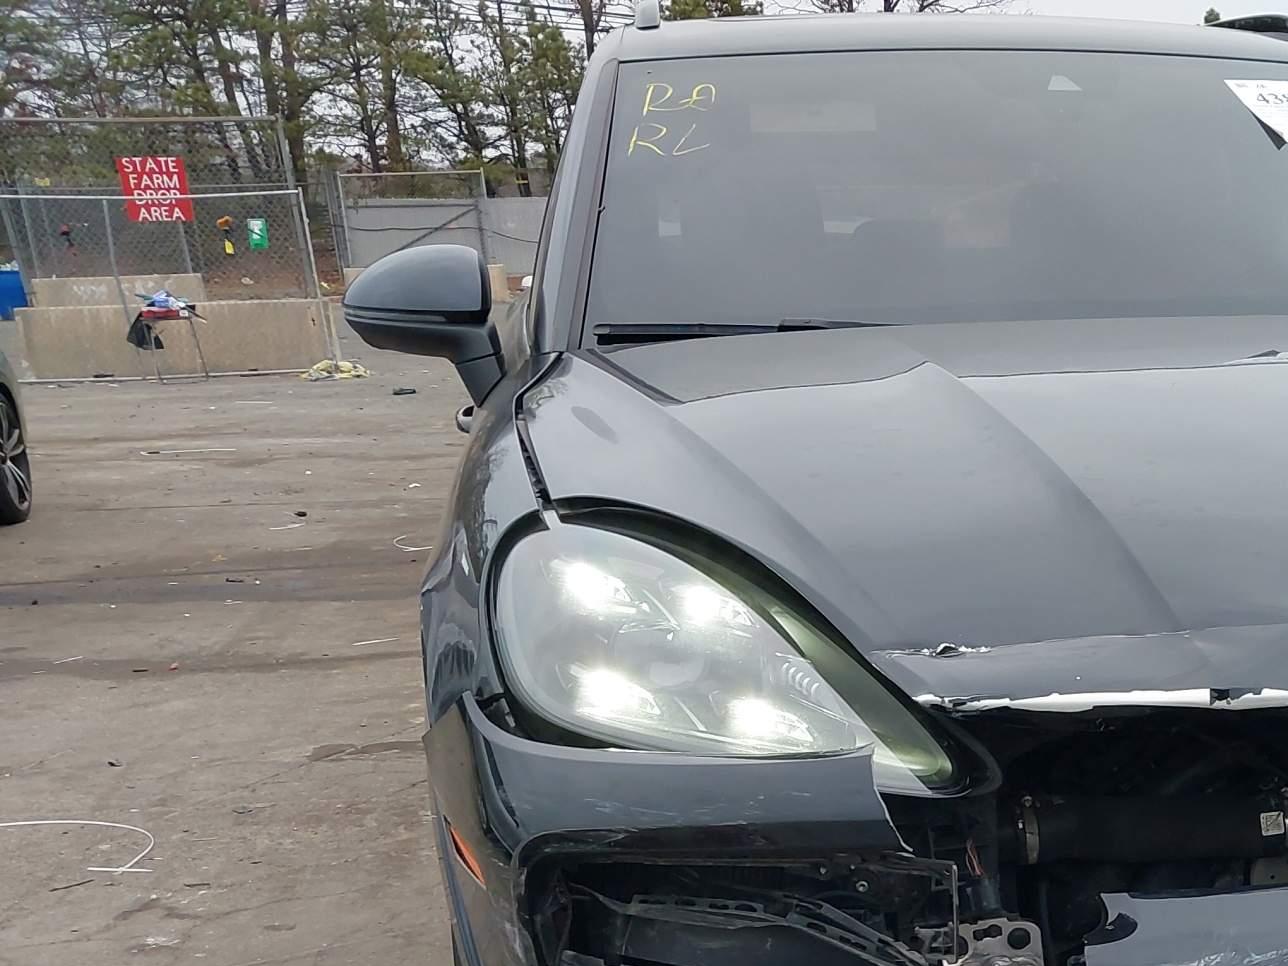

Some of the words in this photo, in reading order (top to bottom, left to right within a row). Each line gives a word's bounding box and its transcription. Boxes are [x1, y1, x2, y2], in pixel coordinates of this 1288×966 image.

[121, 156, 179, 173] STATE
[128, 173, 180, 189] FARM
[133, 189, 181, 205] DROP
[138, 206, 187, 222] AREA
